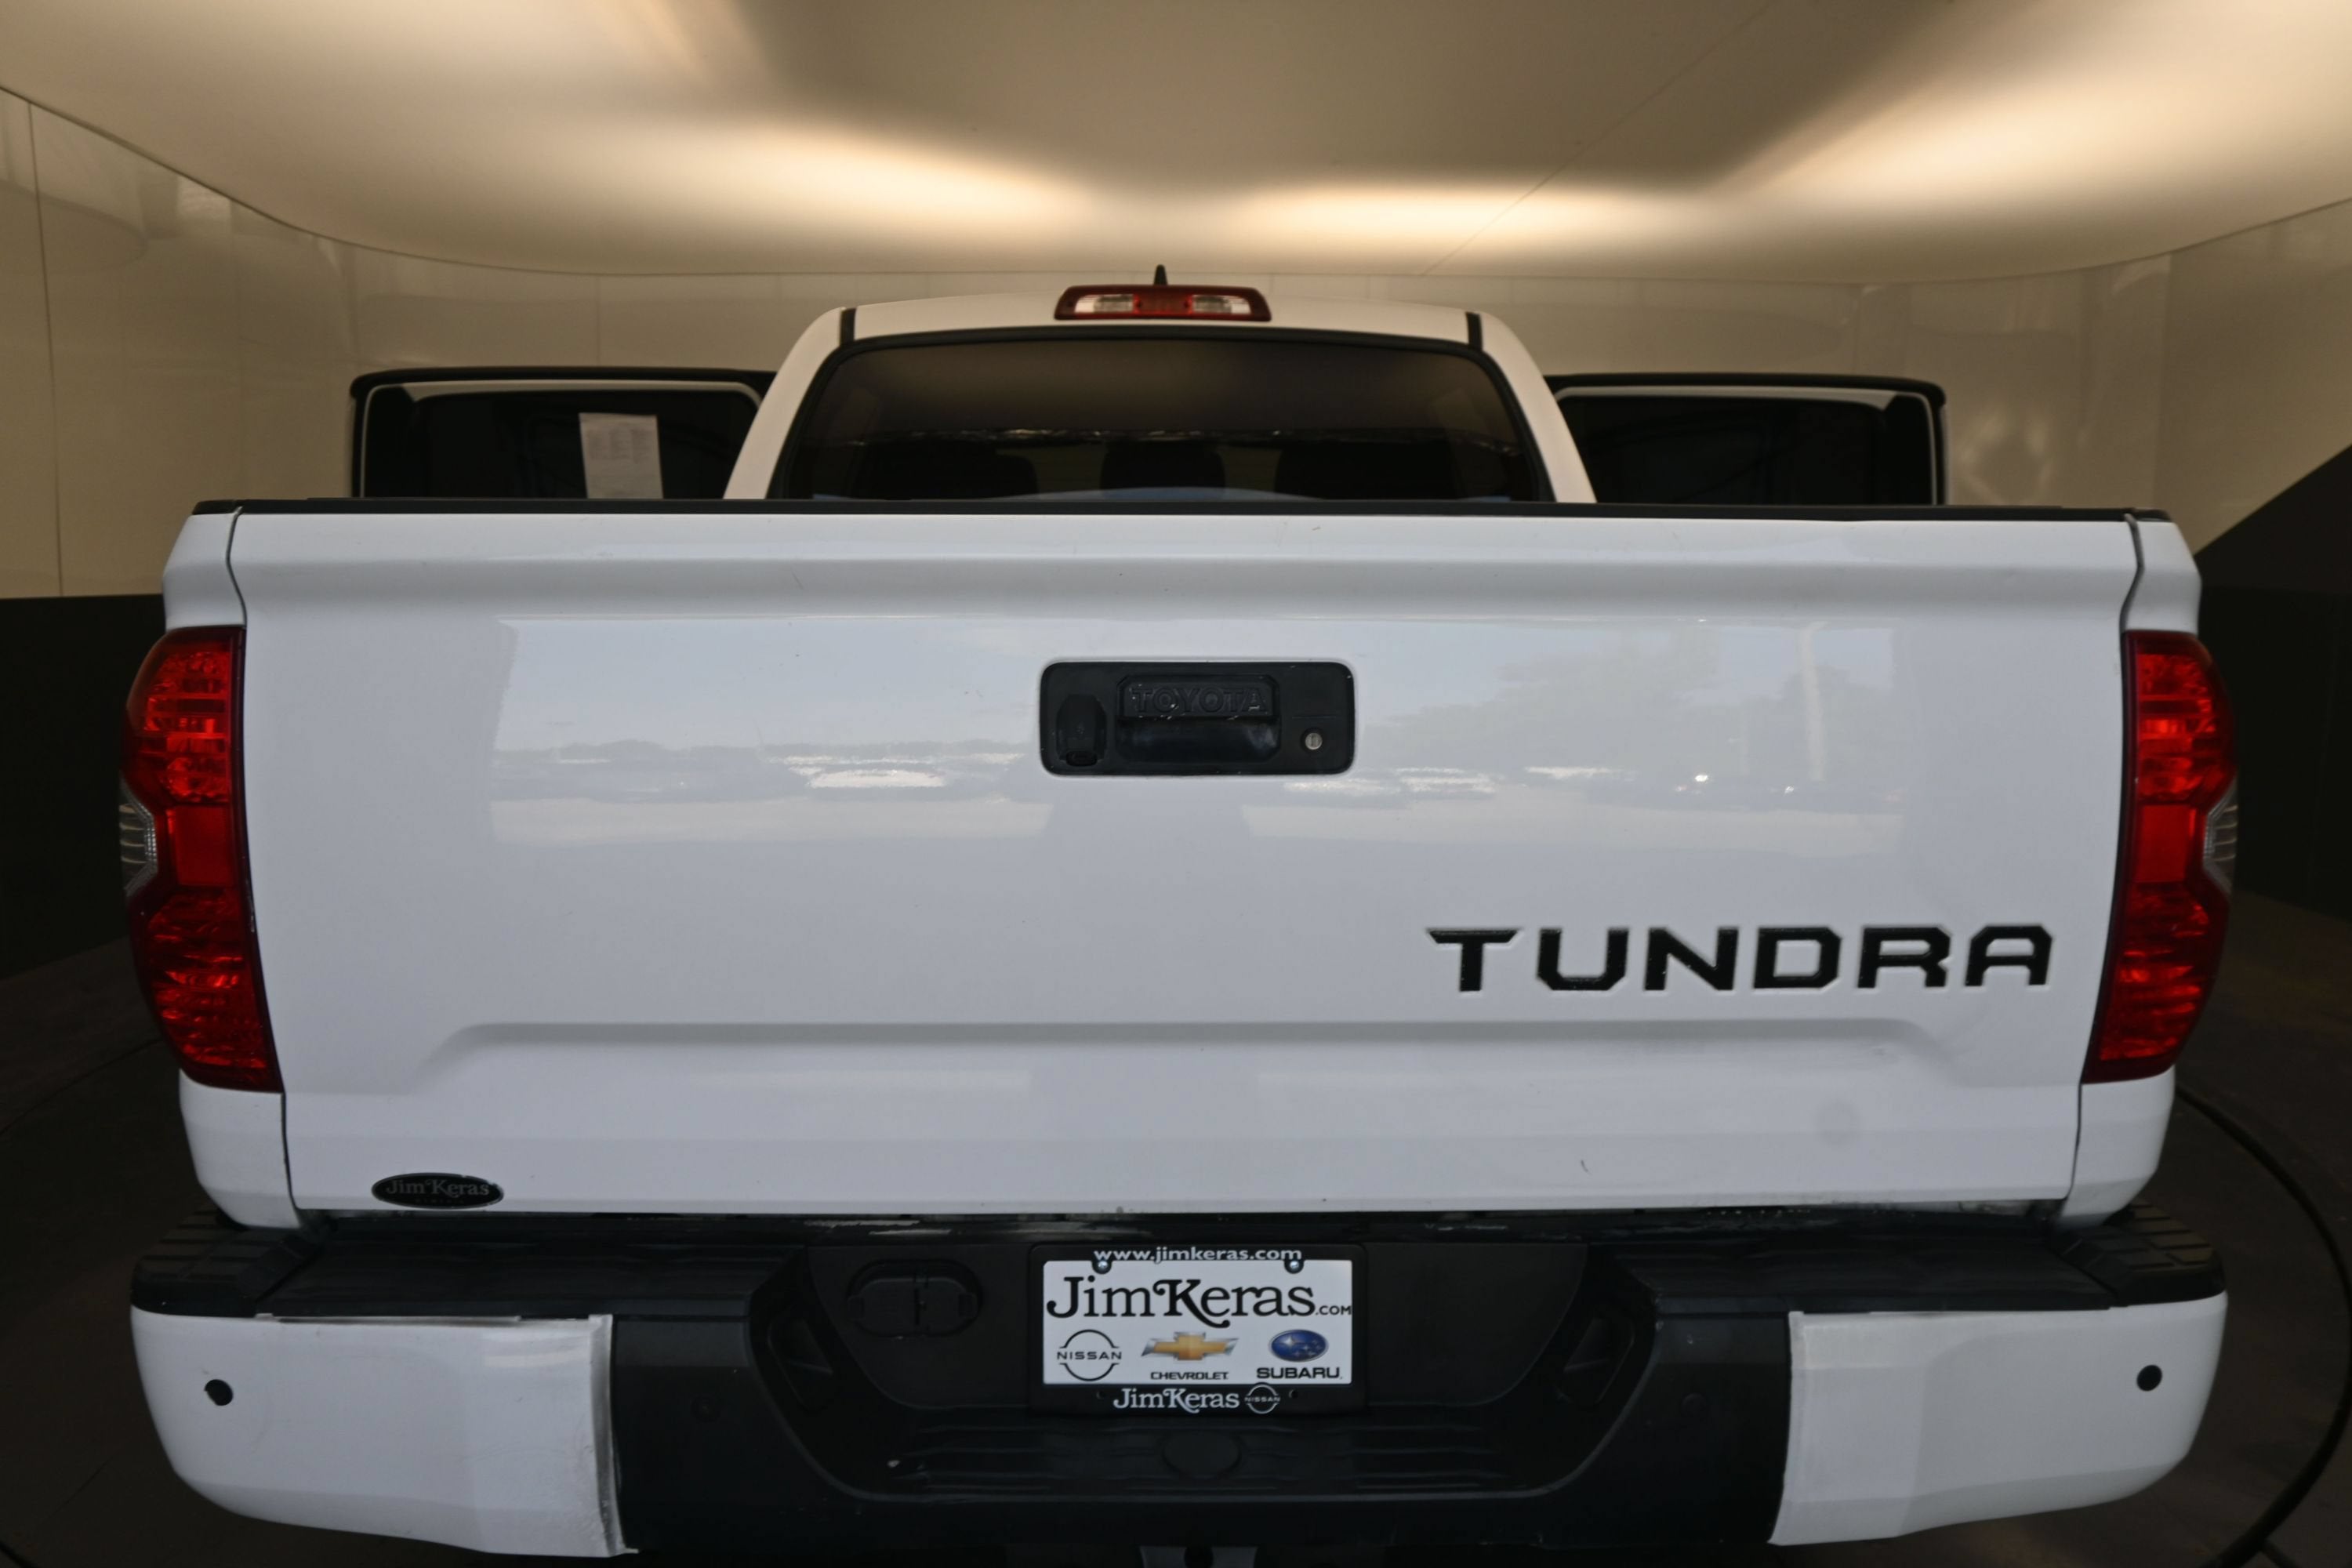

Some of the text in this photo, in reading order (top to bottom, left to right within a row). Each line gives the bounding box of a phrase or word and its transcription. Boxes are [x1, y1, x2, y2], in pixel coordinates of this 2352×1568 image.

[1131, 687, 1268, 713] TOYOTA
[1427, 924, 2053, 992] TUNDRA
[1094, 1247, 1302, 1265] www.jimkeras.com
[1056, 1352, 1122, 1361] NISSAN
[1150, 1371, 1229, 1381] CHEVROLET
[1256, 1367, 1340, 1380] SUBARU
[1244, 1394, 1281, 1403] NISSAN
